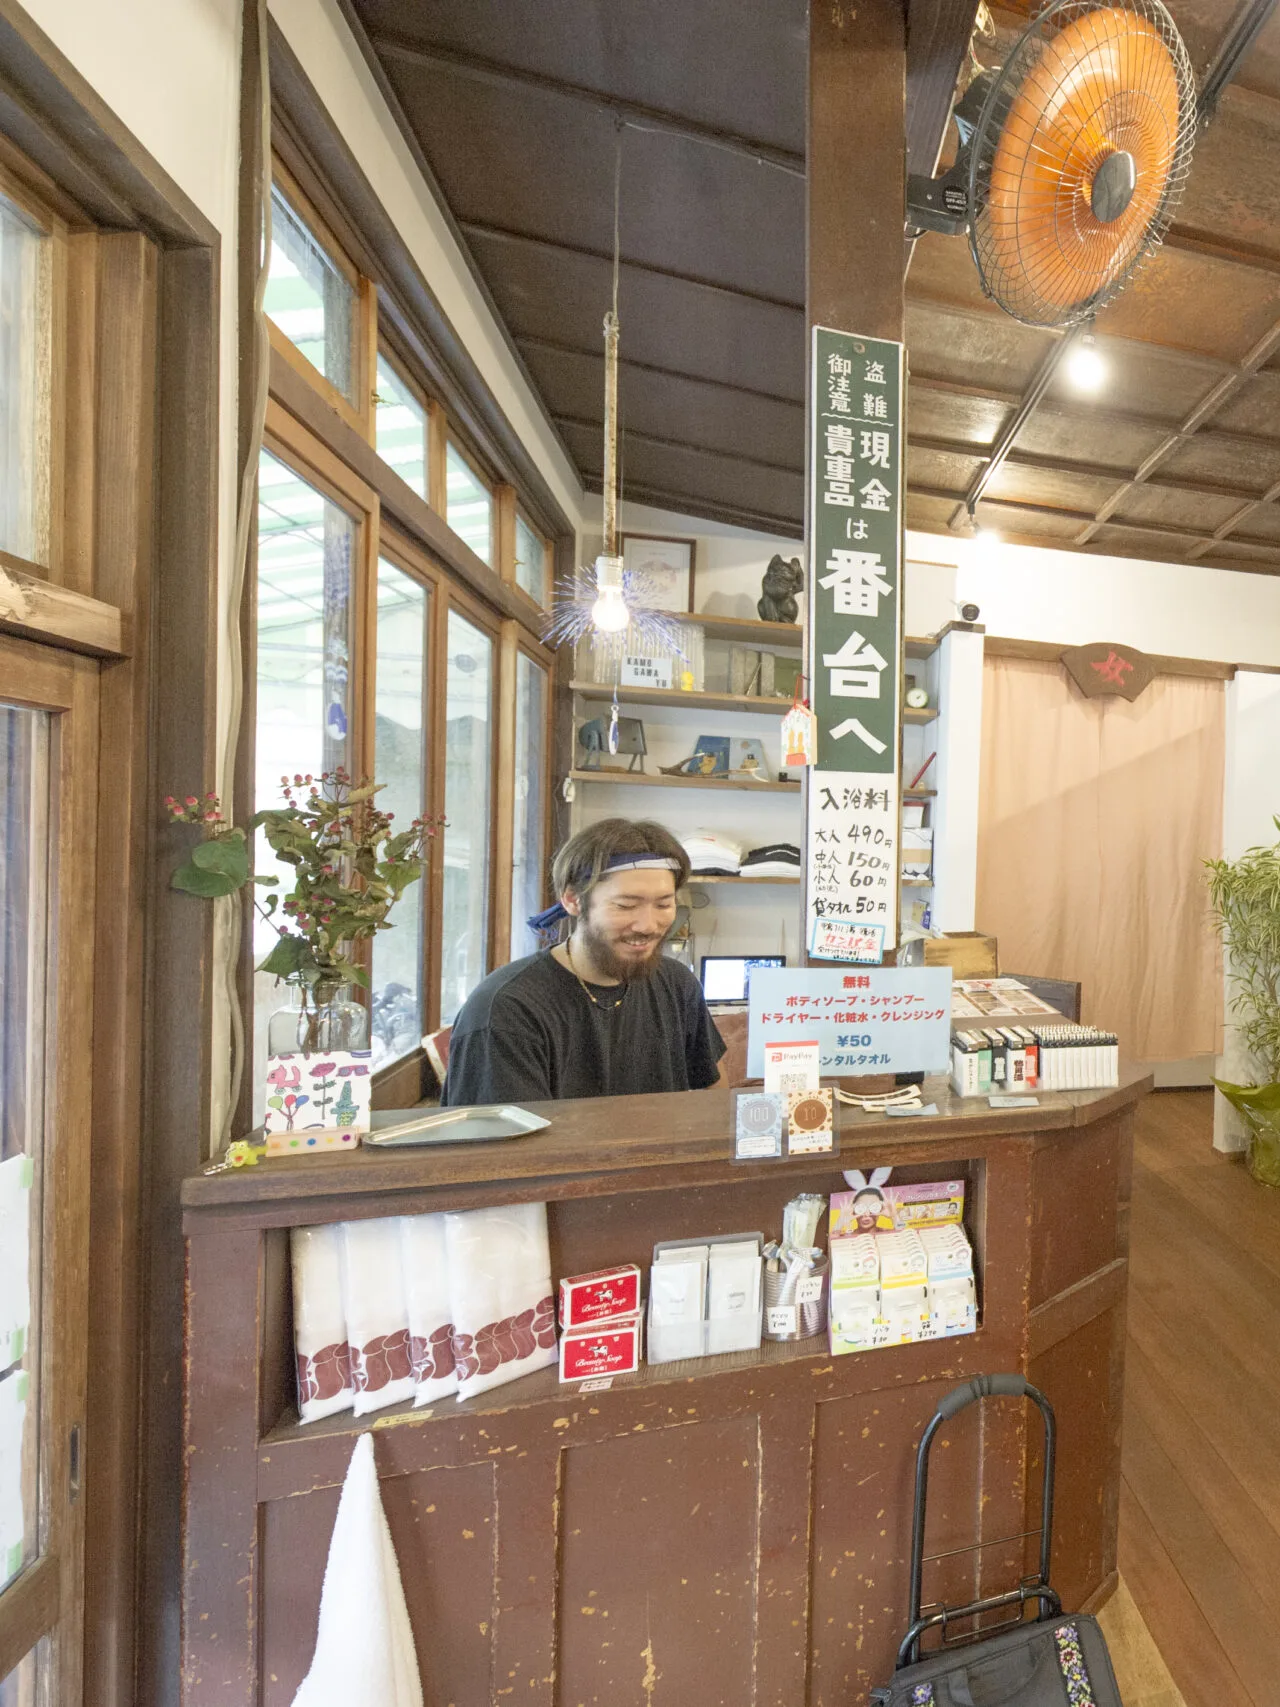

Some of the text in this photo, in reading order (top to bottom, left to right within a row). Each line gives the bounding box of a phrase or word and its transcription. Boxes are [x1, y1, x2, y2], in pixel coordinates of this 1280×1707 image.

[827, 353, 851, 412] 御注意
[864, 360, 888, 418] 盗難
[824, 424, 855, 507] 貴重品
[859, 430, 892, 512] 現金
[627, 657, 652, 667] KAMO
[1089, 649, 1134, 687] 女
[634, 667, 659, 677] GAWA
[656, 679, 667, 687] YU
[820, 787, 892, 811] 入浴料
[814, 823, 893, 848] 大人 490円
[815, 849, 890, 871] 中人 150円
[813, 866, 840, 884] 小人
[855, 896, 887, 914] 50円
[842, 975, 871, 989] 無料
[785, 994, 925, 1007] ボディソープ・シャンプー
[761, 1009, 946, 1024] ドライヤー・化粧水・クレンジング
[836, 1034, 872, 1048] ¥50
[804, 1107, 817, 1122] 10
[581, 1303, 610, 1314] Beauty
[611, 1298, 627, 1306] Soap
[575, 1354, 623, 1369] Beauty Soap
